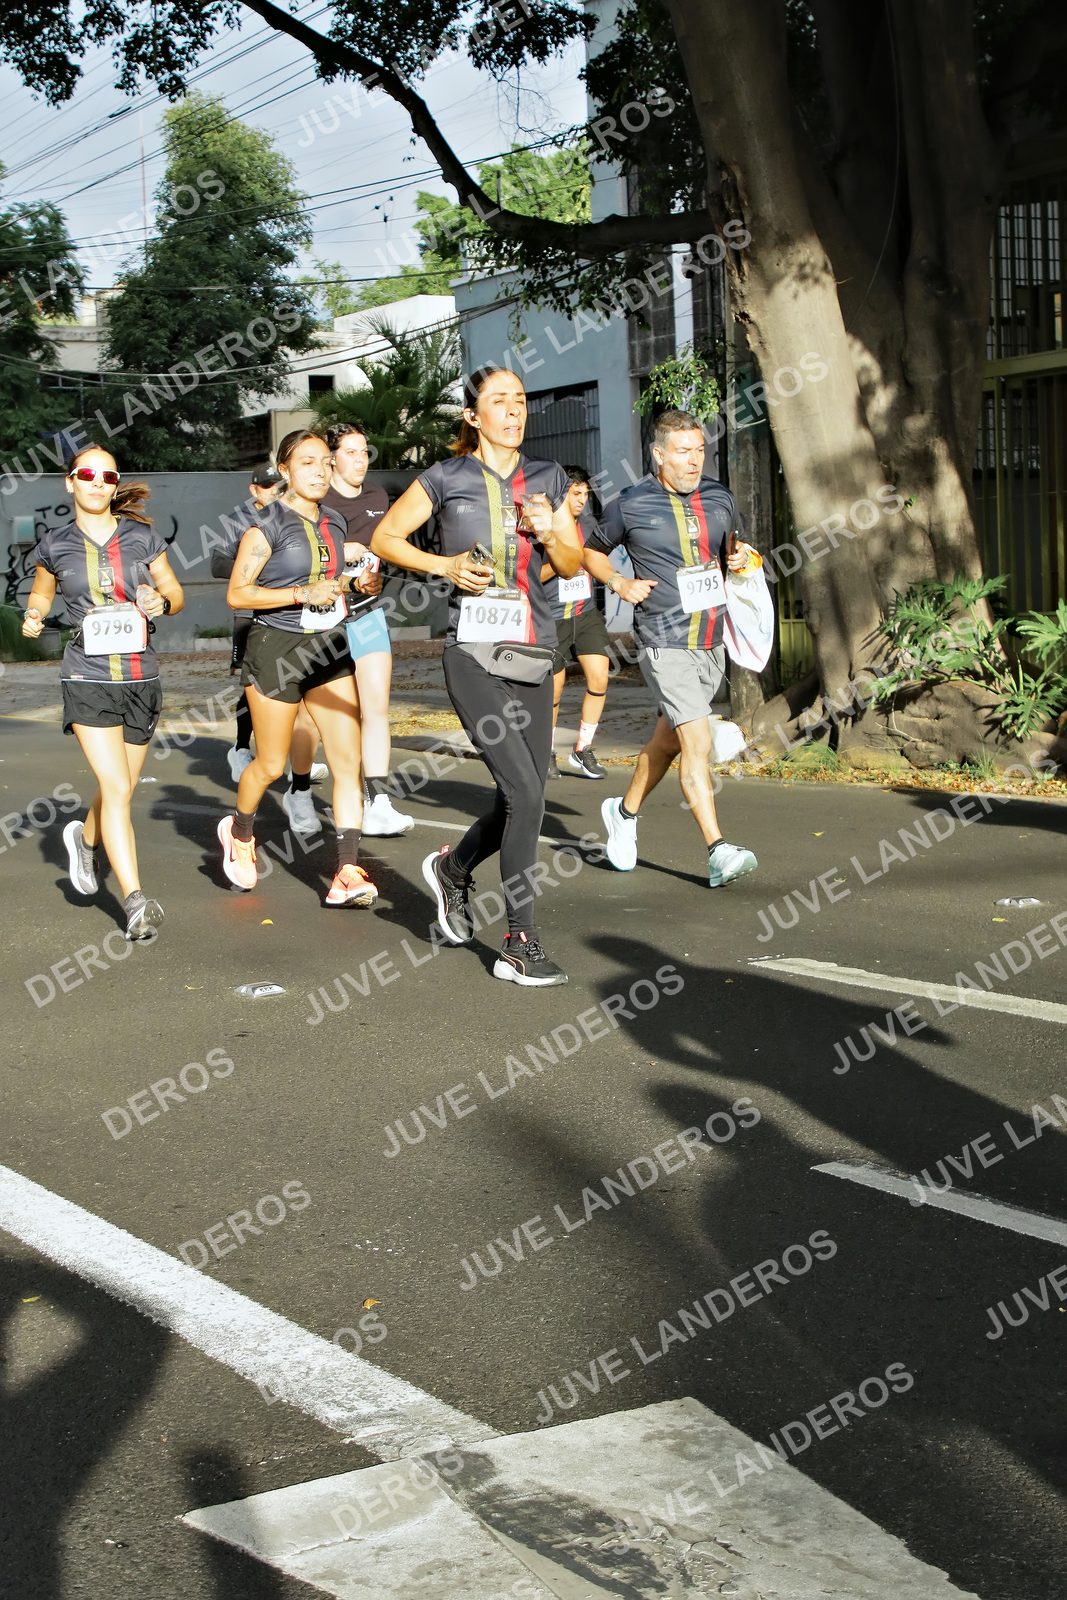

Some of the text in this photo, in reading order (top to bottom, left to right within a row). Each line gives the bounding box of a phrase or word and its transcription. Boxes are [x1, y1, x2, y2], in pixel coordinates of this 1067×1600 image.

[564, 580, 585, 591] 8993
[686, 576, 719, 595] 9795
[465, 605, 522, 627] 10874
[92, 619, 133, 636] 9796
